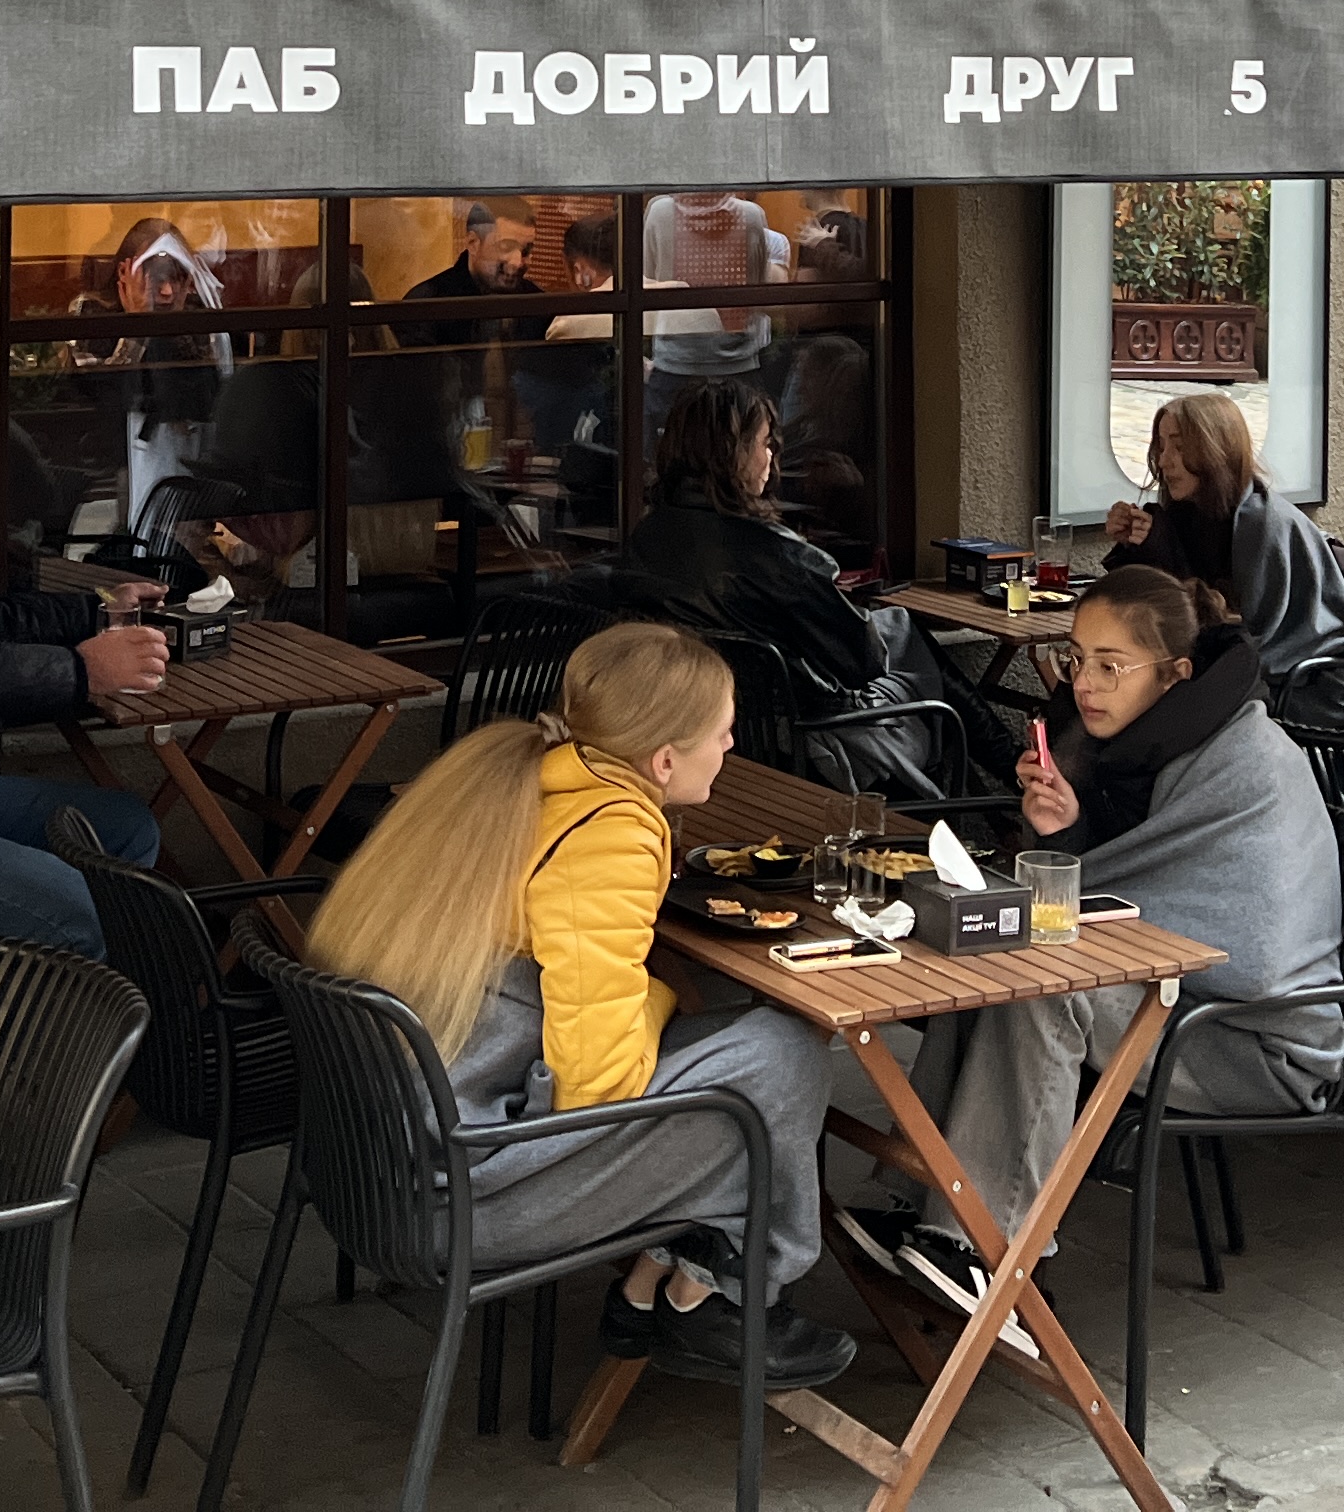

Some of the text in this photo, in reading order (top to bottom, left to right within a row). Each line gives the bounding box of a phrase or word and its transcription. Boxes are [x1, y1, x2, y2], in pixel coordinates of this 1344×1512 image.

[132, 46, 340, 113] ПАБ
[464, 37, 830, 126] ДОБРИЙ
[943, 56, 1134, 124] ДРУГ
[1230, 60, 1267, 114] 5
